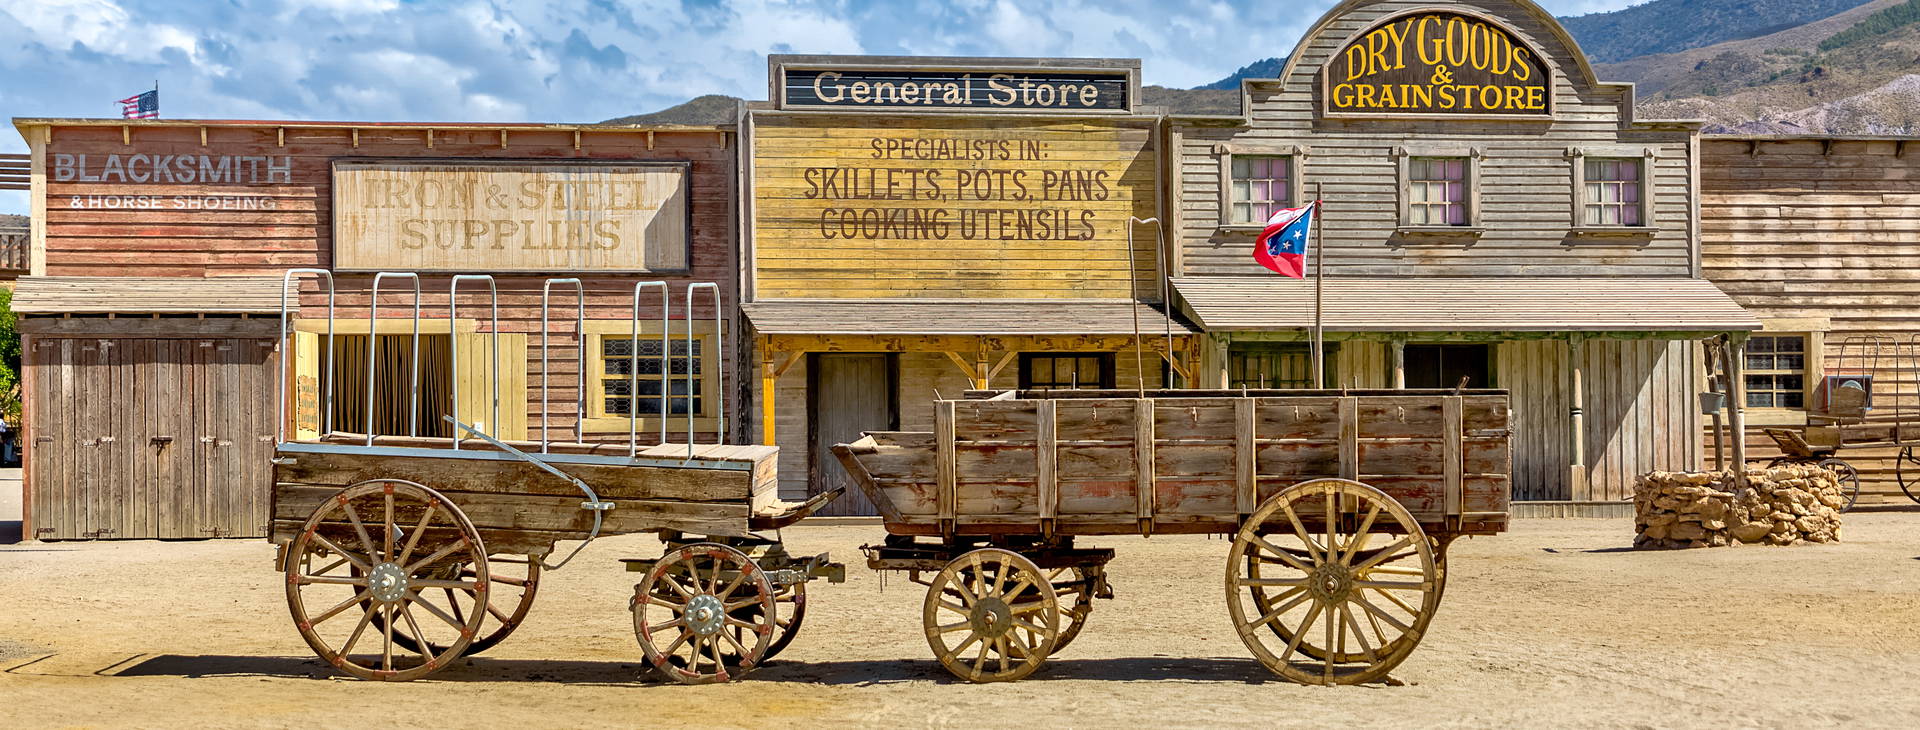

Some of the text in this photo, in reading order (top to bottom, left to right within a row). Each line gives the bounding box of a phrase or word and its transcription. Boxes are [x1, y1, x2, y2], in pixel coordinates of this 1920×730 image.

[1346, 15, 1530, 81] DRY GOODS
[813, 72, 1099, 107] General Store
[1431, 65, 1454, 85] &
[1333, 83, 1545, 110] GRAIN STORE
[870, 138, 1049, 161] SPECIALISTS IN:
[54, 153, 292, 184] BLACKSMITH
[364, 178, 659, 211] IRON & STEEL
[803, 168, 1109, 203] SKILLETS, POTS, PANS
[70, 195, 276, 211] & HORSE SHOEING
[401, 219, 622, 251] SUPPLIES
[820, 208, 1096, 241] COOKING UTENSILS
